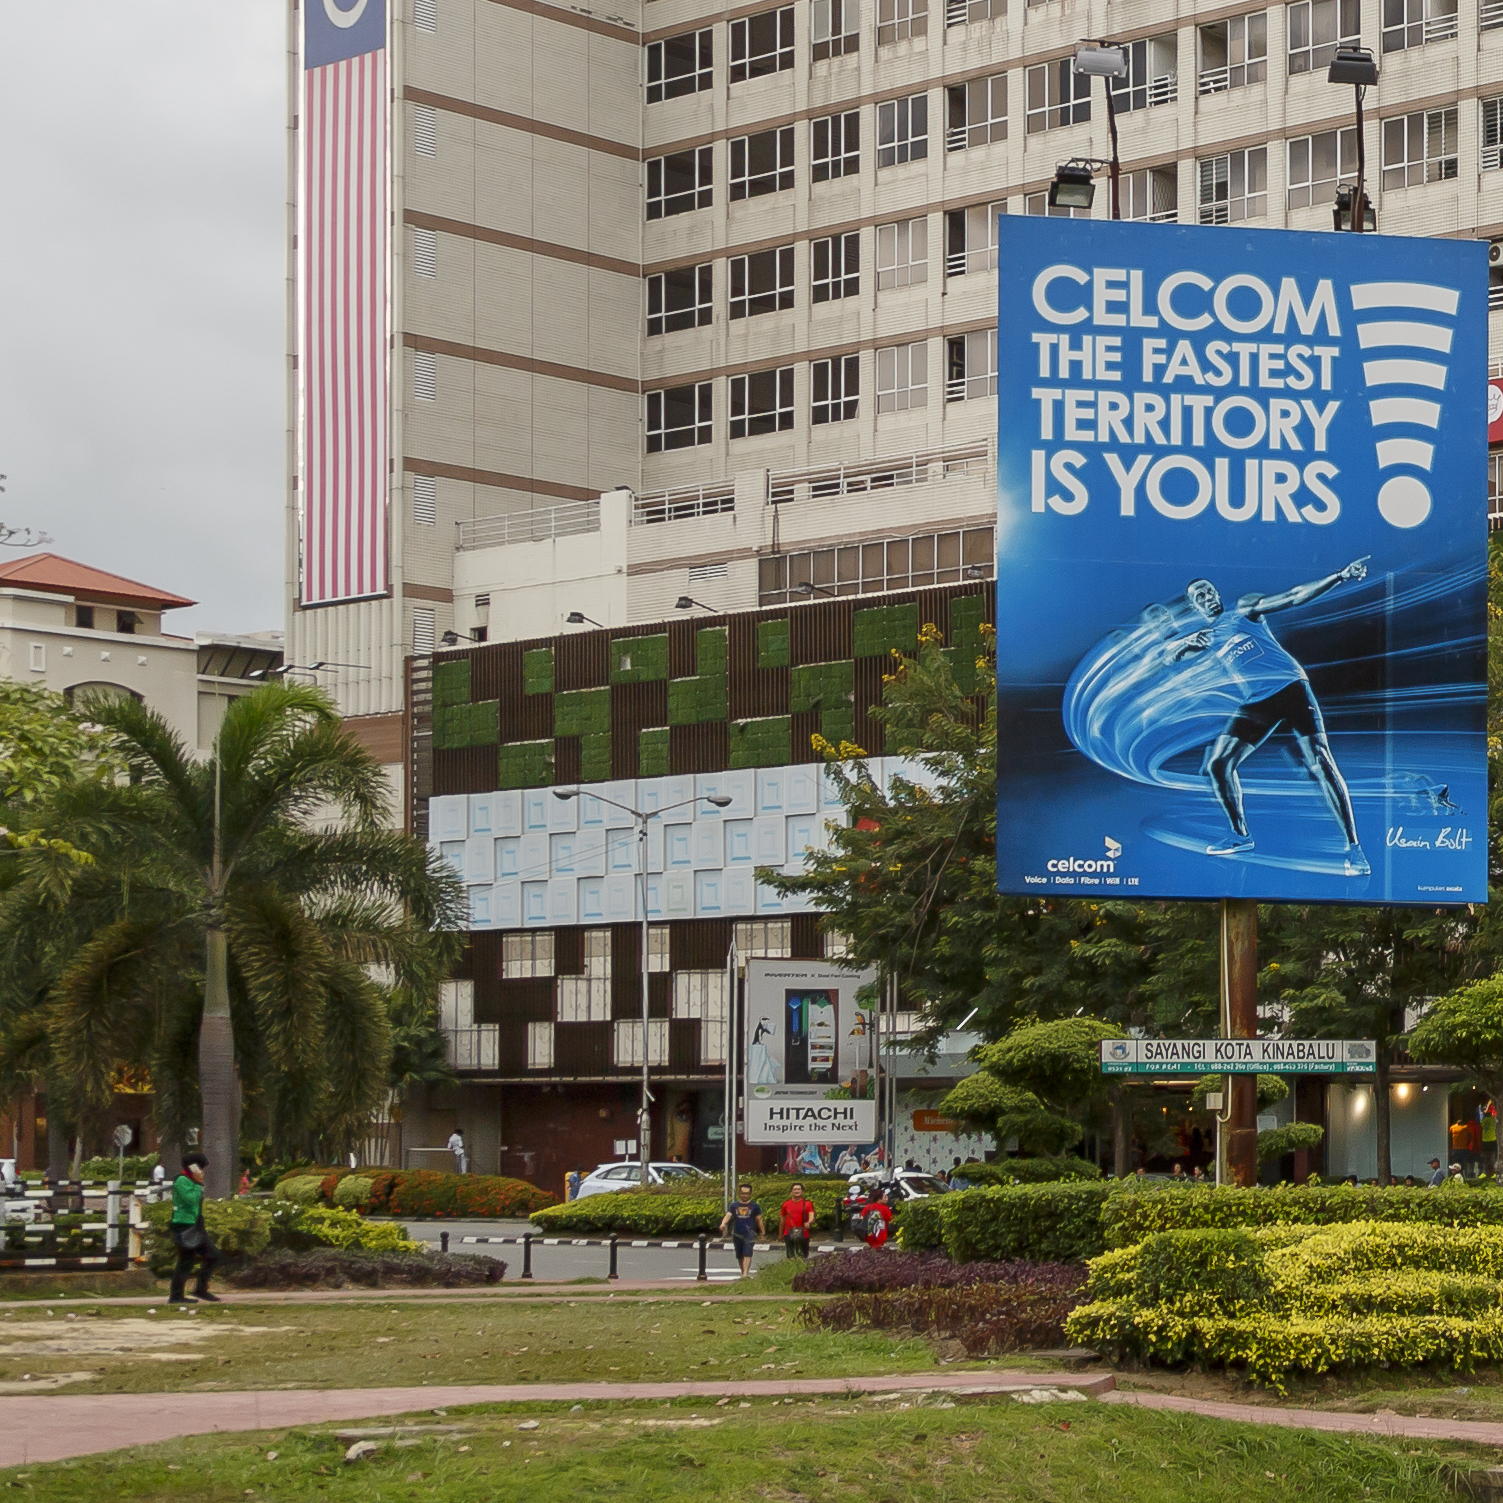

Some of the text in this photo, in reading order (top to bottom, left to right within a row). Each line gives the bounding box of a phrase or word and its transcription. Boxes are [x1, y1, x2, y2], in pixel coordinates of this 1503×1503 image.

[1031, 264, 1341, 337] CELCOM
[1031, 332, 1340, 390] THE FASTEST
[1031, 387, 1341, 452] TERRITORY
[1031, 449, 1341, 525] IS YOURS
[1435, 826, 1473, 850] Bolt
[1046, 856, 1114, 873] celcom
[1024, 875, 1048, 884] Voice
[1144, 1041, 1336, 1061] SAYANGI KOTA KINABALU
[768, 1106, 855, 1121] HITACHI
[763, 1120, 859, 1134] Inspire the Next
